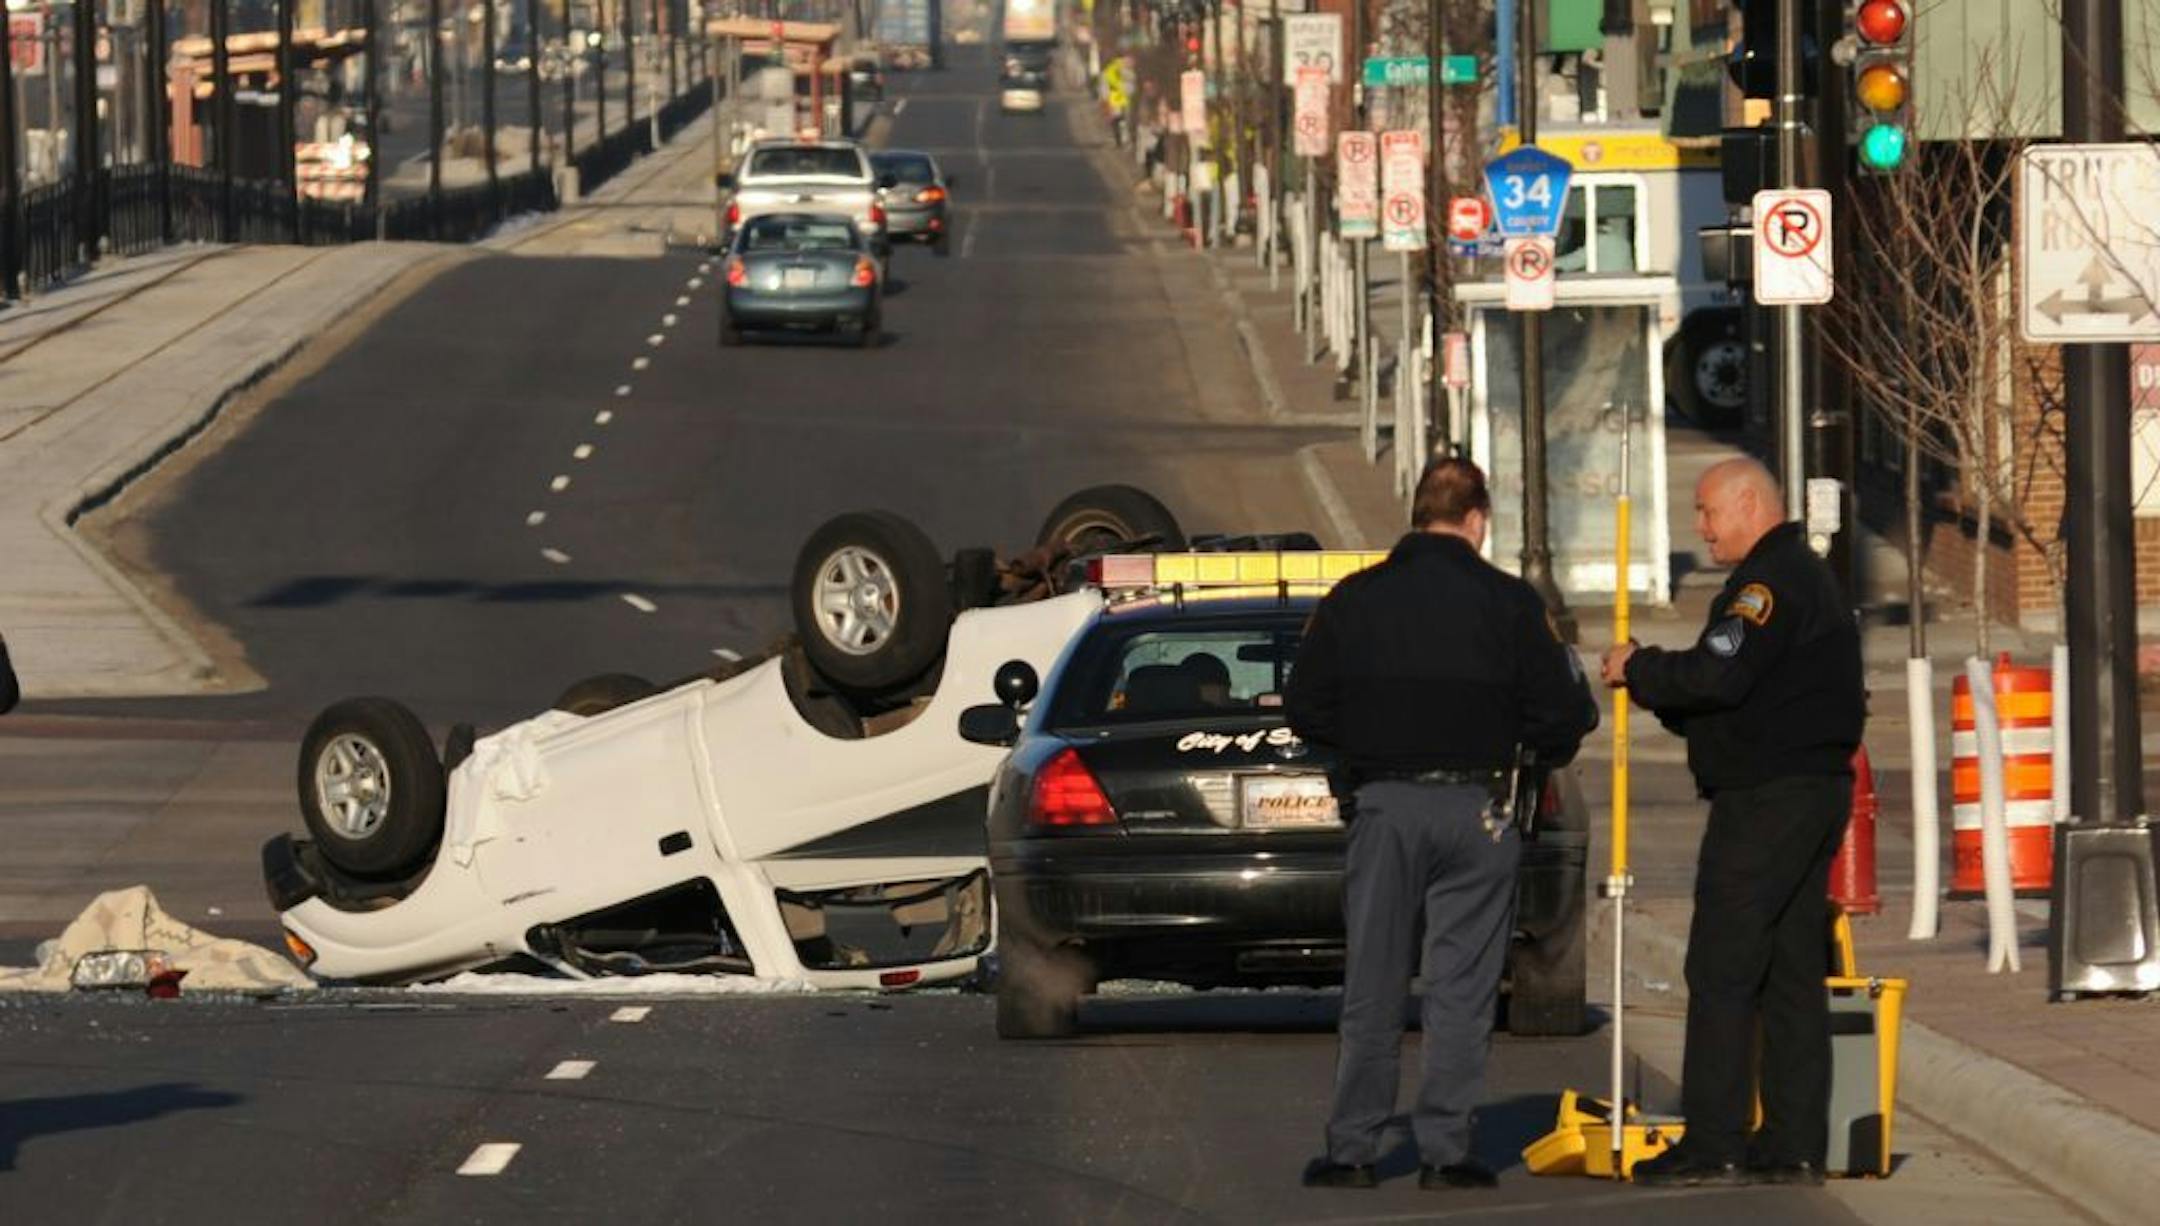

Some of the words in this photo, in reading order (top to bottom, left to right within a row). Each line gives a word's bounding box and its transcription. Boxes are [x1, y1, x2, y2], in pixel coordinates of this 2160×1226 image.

[1504, 173, 1552, 209] 34
[1176, 731, 1234, 753] City
[1235, 729, 1267, 752] of
[1257, 796, 1326, 809] POLICE
